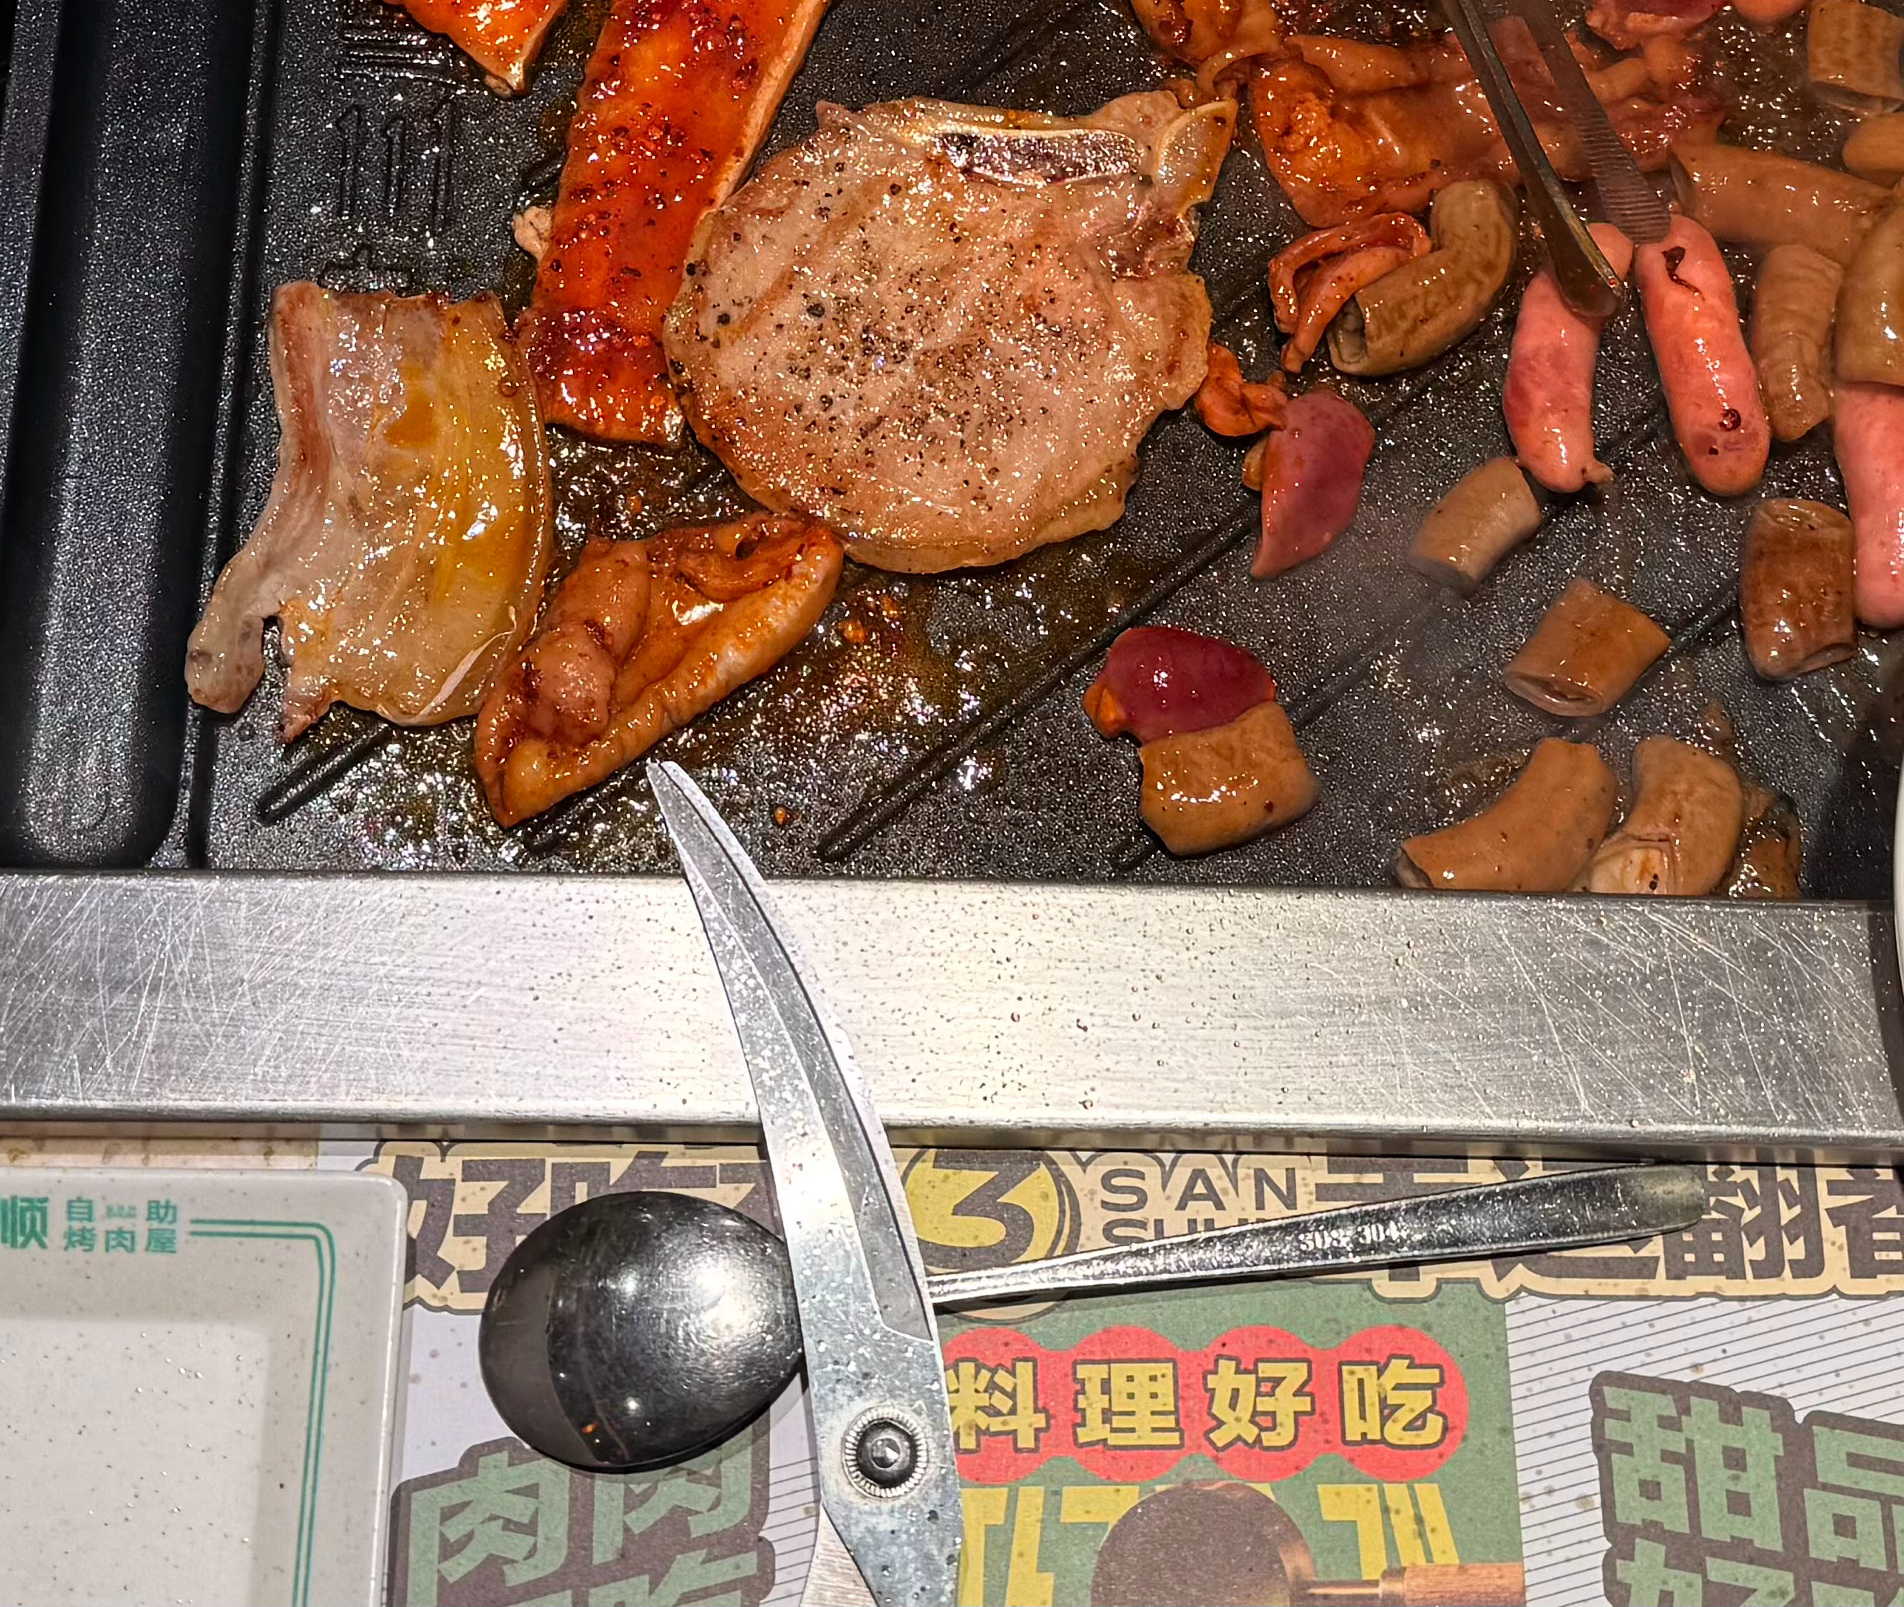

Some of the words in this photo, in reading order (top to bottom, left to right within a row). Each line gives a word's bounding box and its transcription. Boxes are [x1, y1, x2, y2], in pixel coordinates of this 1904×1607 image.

[1099, 1166, 1298, 1213] SAN
[63, 1226, 178, 1254] 烤肉屋
[946, 1357, 1447, 1451] 料理好吃
